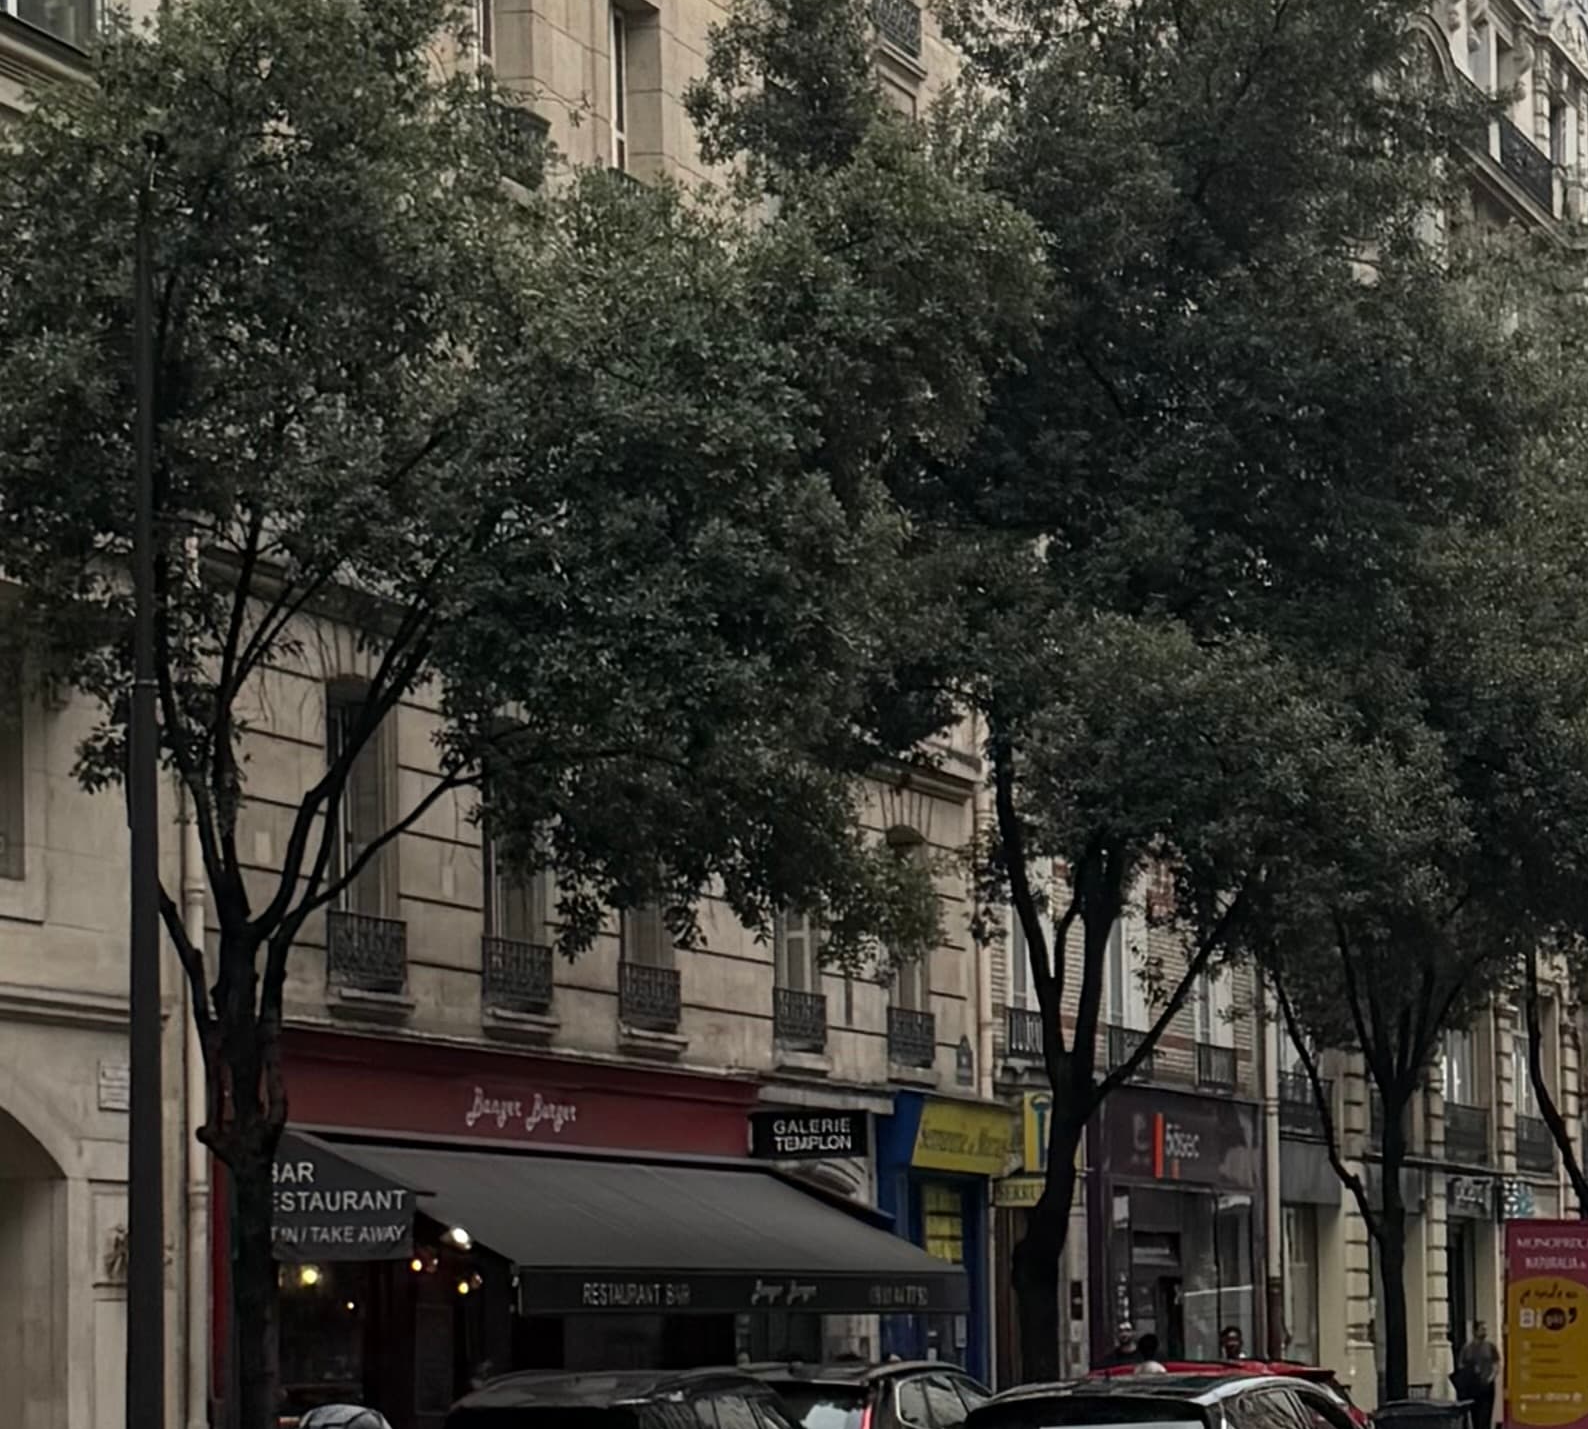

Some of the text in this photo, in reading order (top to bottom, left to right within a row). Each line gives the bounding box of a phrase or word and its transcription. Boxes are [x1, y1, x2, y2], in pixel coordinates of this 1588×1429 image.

[773, 1117, 851, 1135] GALERIE
[774, 1135, 852, 1152] TEMPLON
[272, 1190, 407, 1212] STAURANT
[310, 1226, 355, 1243] TAKE
[358, 1225, 407, 1243] AWAY
